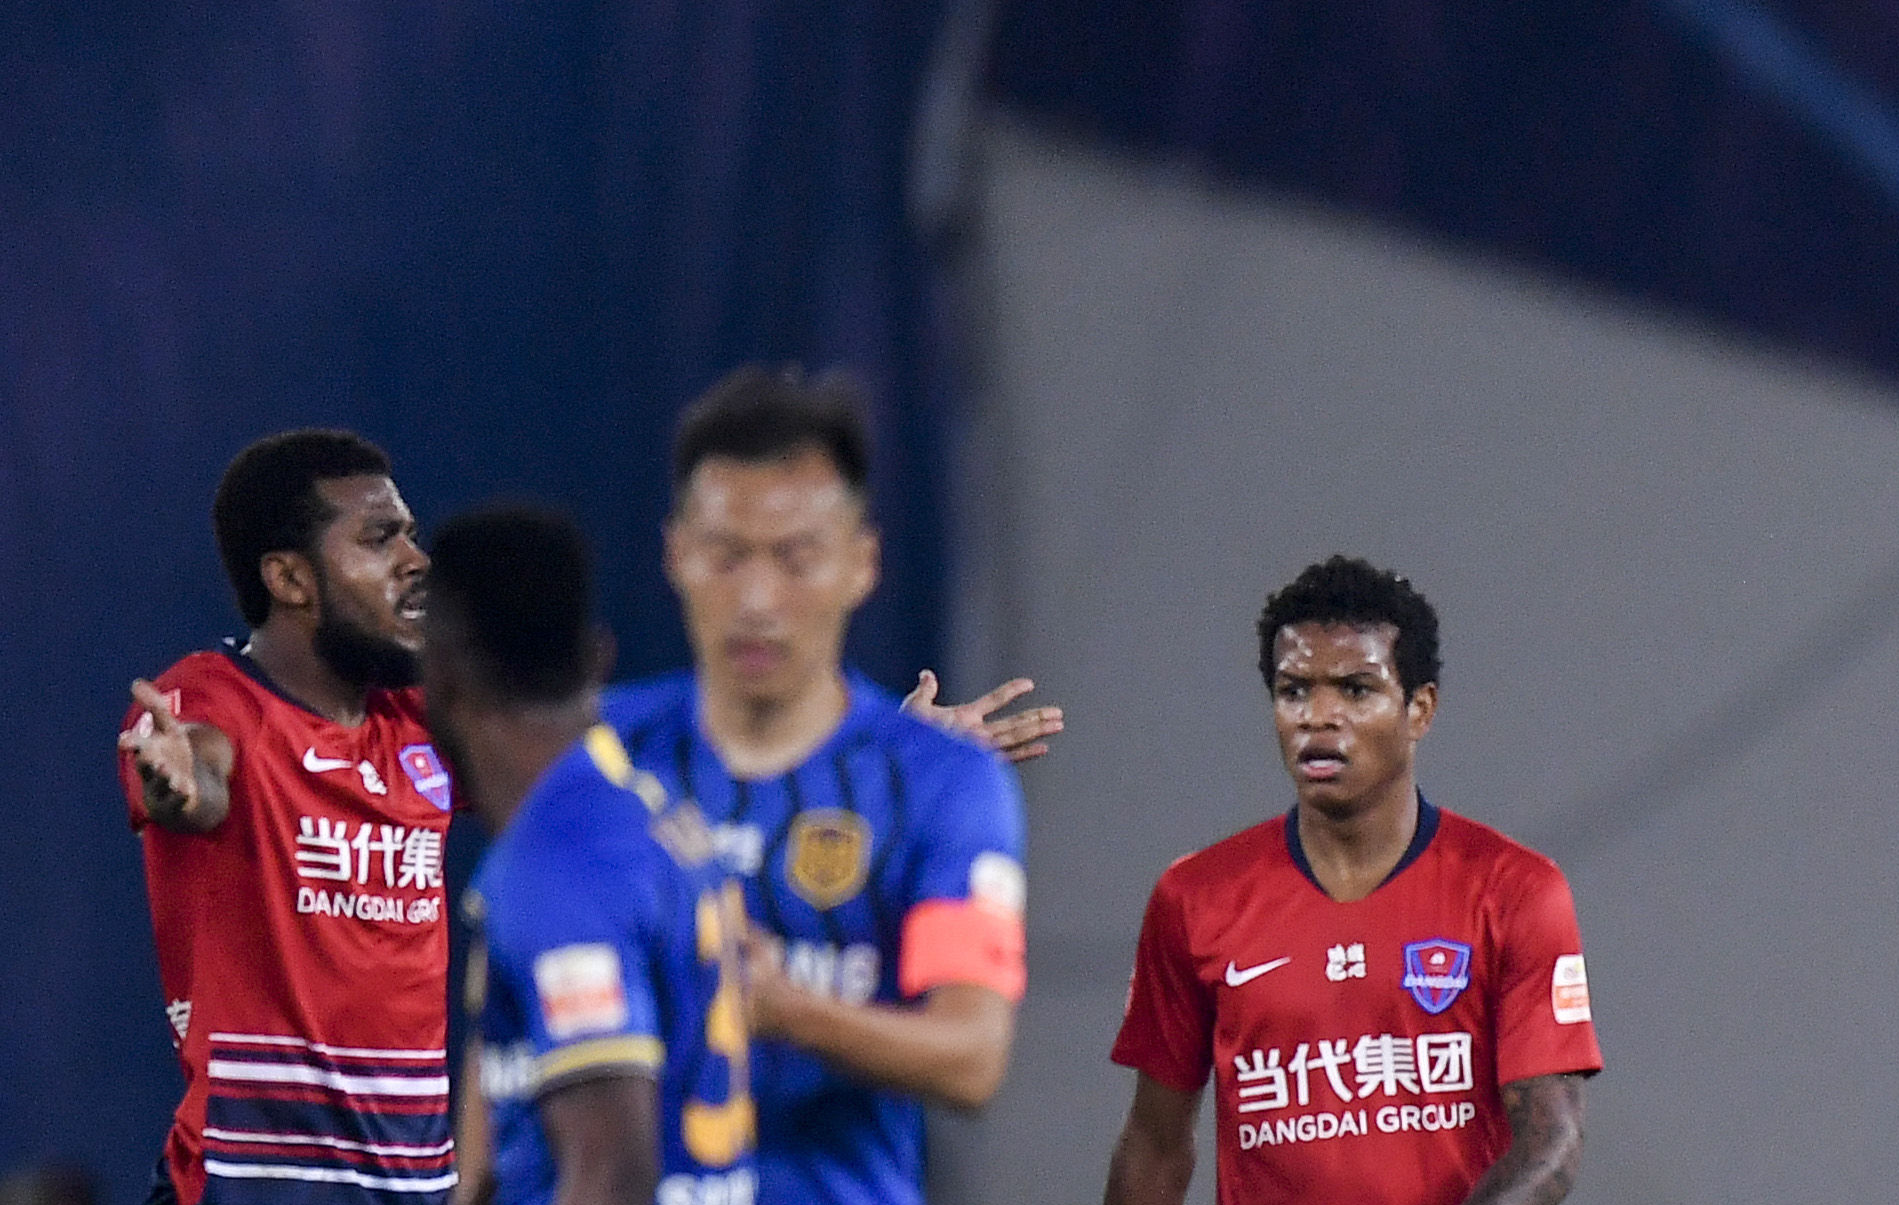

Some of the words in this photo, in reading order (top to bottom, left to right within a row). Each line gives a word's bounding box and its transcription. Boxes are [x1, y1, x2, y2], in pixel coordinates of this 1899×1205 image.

[297, 886, 403, 923] DANGDAI
[1233, 1031, 1474, 1114] 当代集团
[1238, 1108, 1369, 1151] DANGDAI
[1375, 1101, 1476, 1133] GROUP
